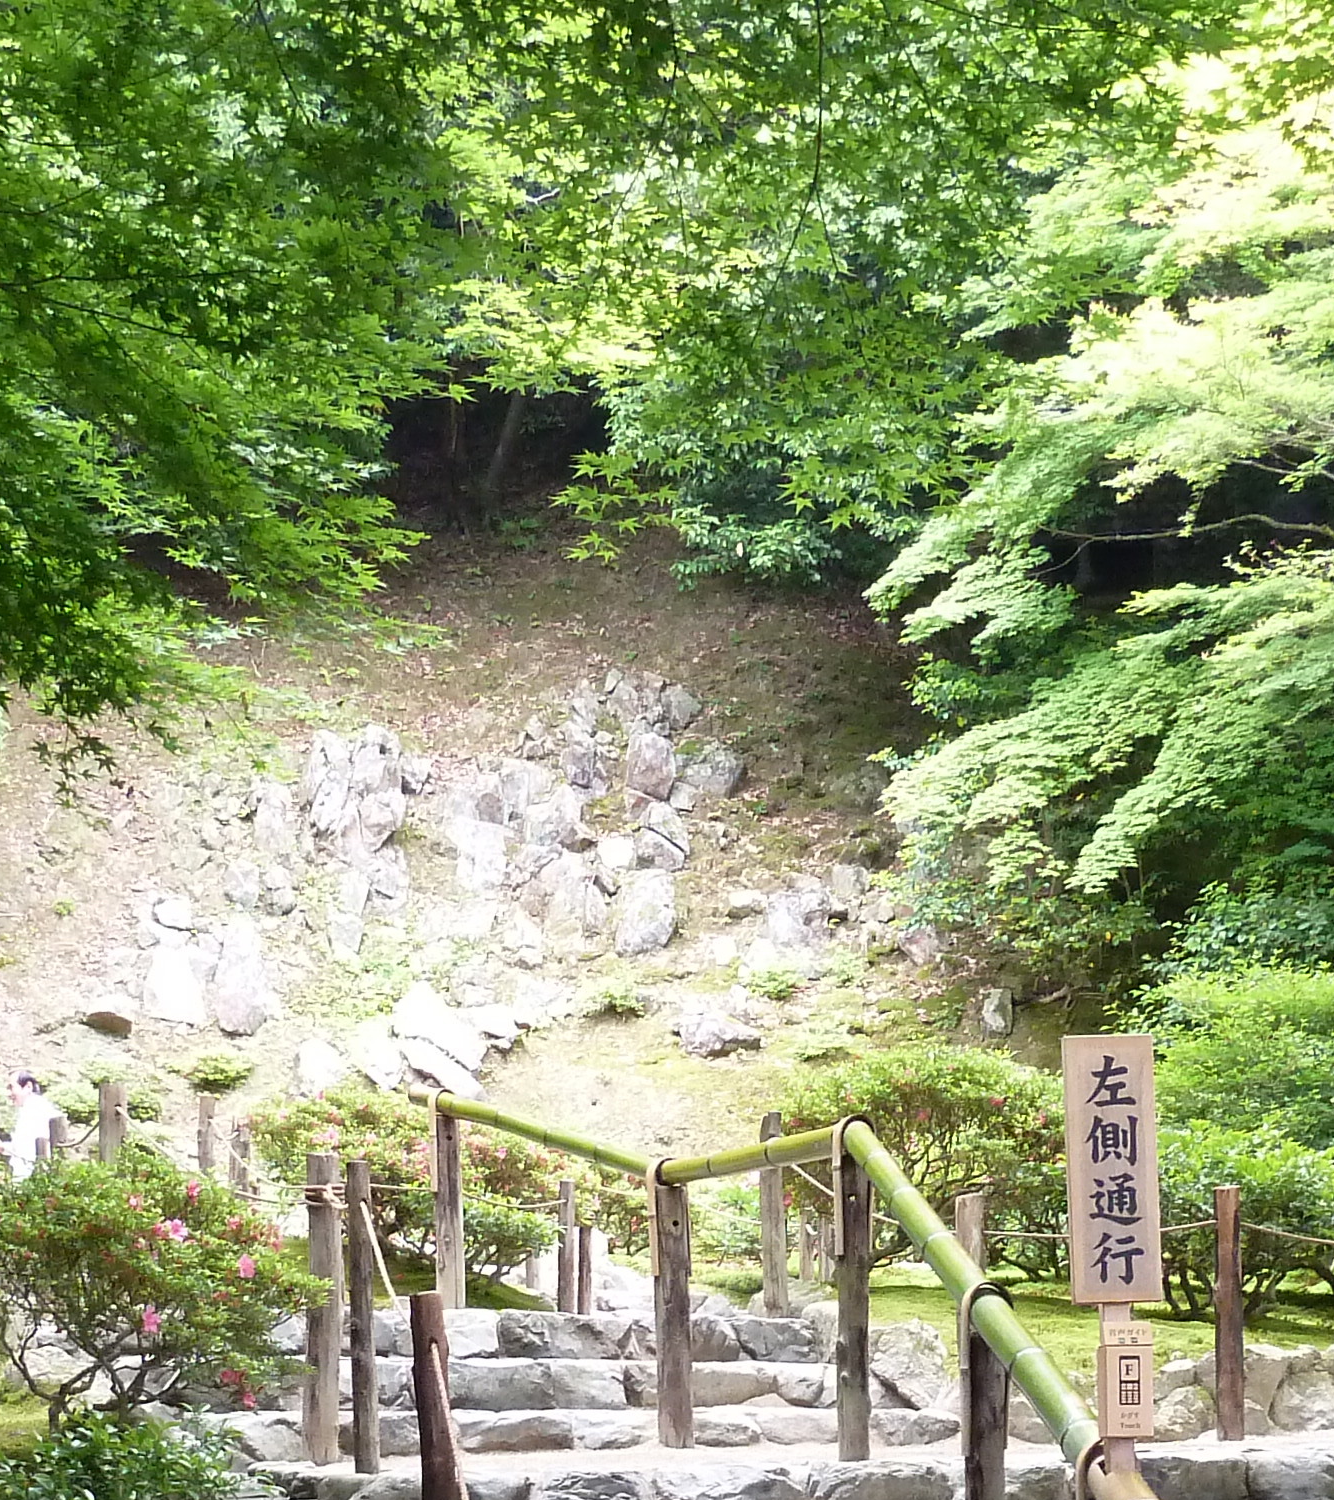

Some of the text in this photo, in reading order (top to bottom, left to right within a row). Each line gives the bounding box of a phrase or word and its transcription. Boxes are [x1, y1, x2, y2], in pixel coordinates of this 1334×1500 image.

[1085, 1055, 1145, 1286] 左側通行
[1120, 1422, 1141, 1430] Touch
